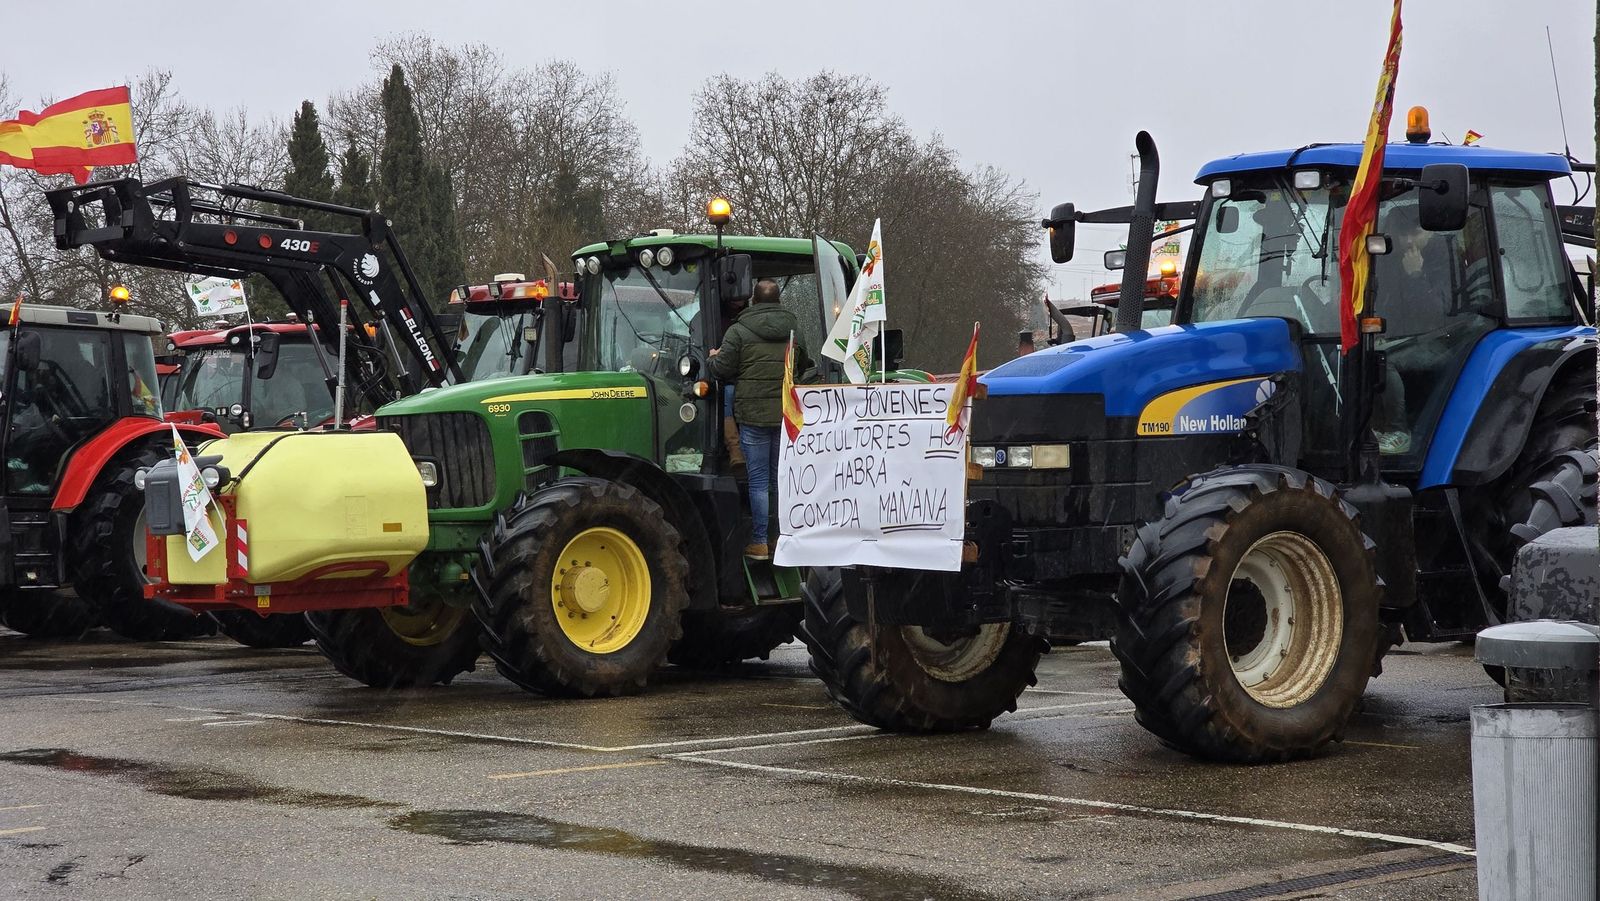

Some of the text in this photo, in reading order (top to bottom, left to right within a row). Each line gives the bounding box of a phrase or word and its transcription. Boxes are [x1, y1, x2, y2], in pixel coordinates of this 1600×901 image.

[280, 238, 320, 253] 430E
[591, 389, 635, 398] JOHN DEERE
[802, 386, 947, 426] SIN JÓVENES
[488, 404, 511, 414] 6930
[1142, 415, 1247, 432] TM190 New Hollan
[784, 423, 911, 461] AGRICULTORES
[788, 464, 817, 498] NO
[788, 477, 947, 529] COMIDA MAÑANA
